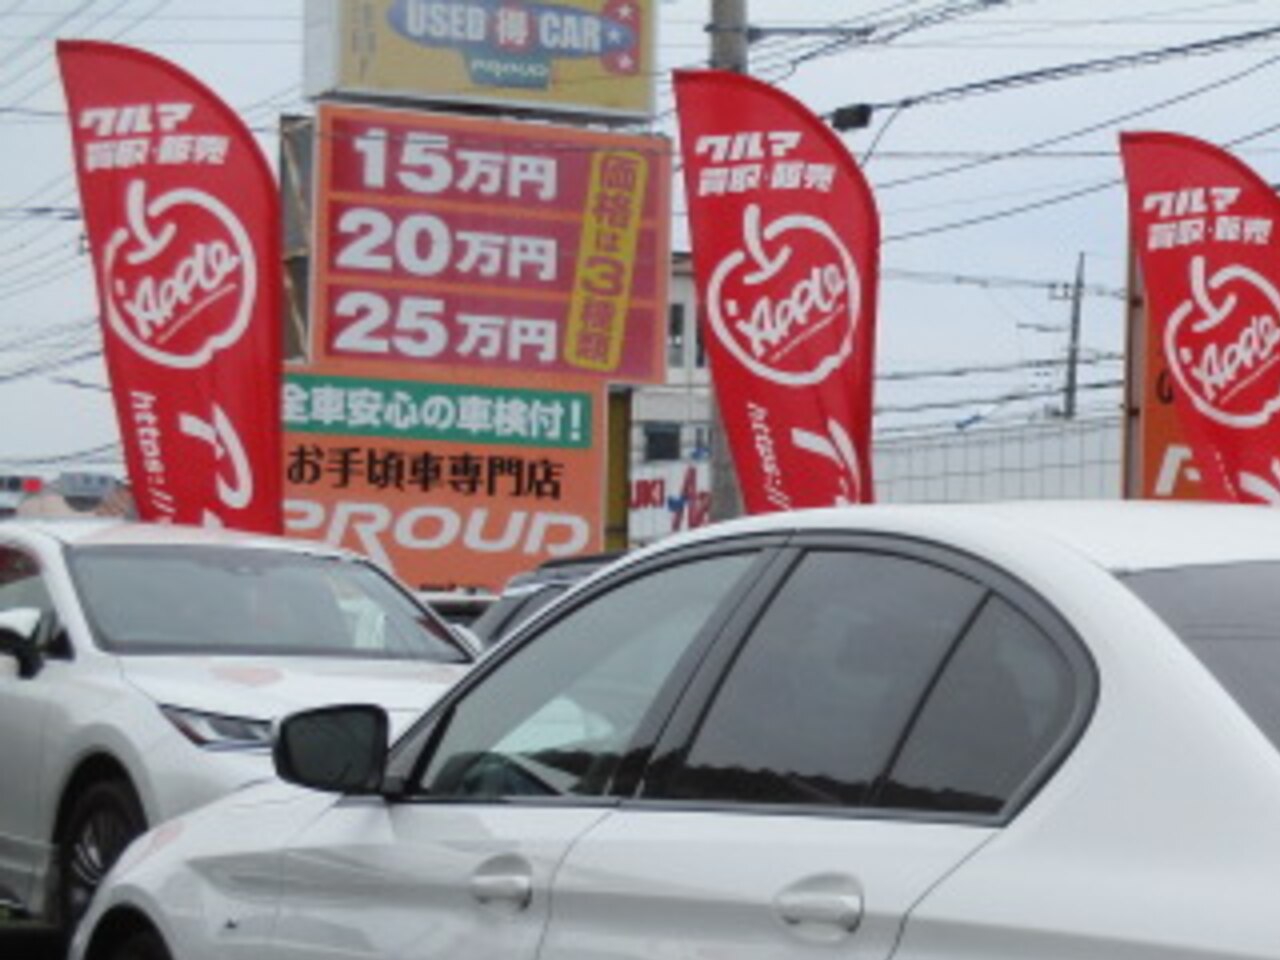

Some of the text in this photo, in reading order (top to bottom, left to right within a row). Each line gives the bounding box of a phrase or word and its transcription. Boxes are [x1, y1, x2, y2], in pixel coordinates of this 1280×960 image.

[539, 14, 602, 51] CAR
[79, 102, 194, 137] クルマ
[353, 128, 558, 201] 15万円
[695, 131, 802, 163] クルマ
[1142, 186, 1241, 218] クルマ
[335, 208, 558, 281] 20万円
[333, 291, 558, 364] 25万円
[286, 444, 565, 500] お手頃車専門店
